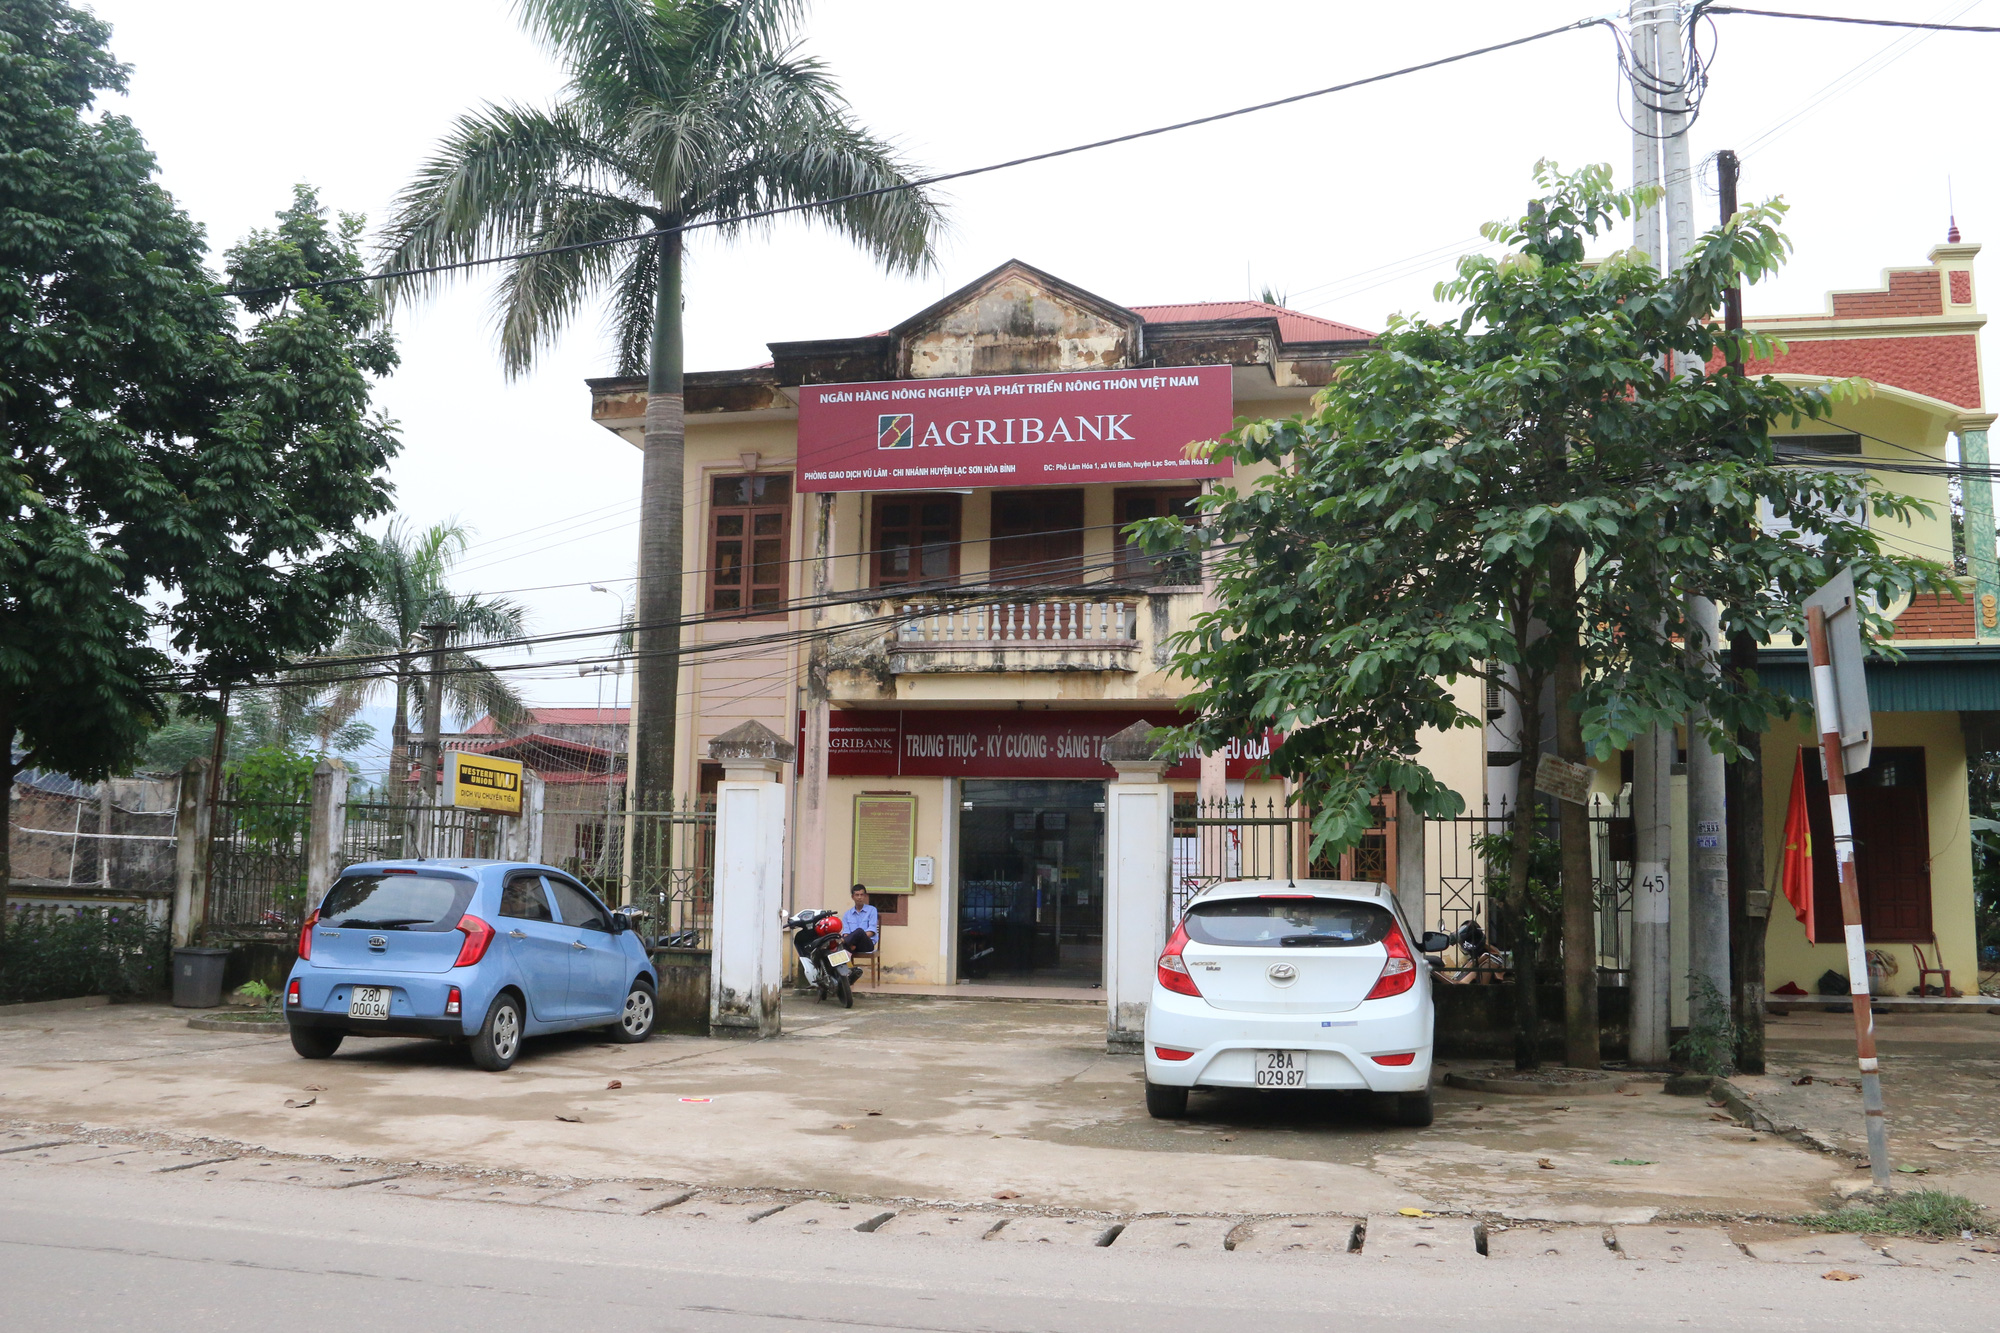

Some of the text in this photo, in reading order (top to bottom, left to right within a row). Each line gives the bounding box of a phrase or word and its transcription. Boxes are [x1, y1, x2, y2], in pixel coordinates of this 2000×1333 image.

[819, 375, 1200, 404] NGÂN HÀNG NÔNG NGHIỆP VÀ PHÁT TRIỂN NÔNG THÔN VIỆT NAM
[918, 413, 1136, 447] AGRIBANK
[804, 471, 827, 480] PHÒNG
[828, 471, 845, 480] GIAO
[845, 470, 862, 481] DỊCH
[862, 468, 872, 478] VŨ
[873, 468, 888, 478] LÂM
[892, 468, 904, 477] CHI
[904, 466, 929, 476] NHÁNH
[929, 465, 952, 477] HUYỆN
[952, 465, 967, 476] LẠC
[968, 464, 983, 474] SƠN
[983, 463, 999, 473] HÒA
[1000, 463, 1016, 473] BÌNH
[1094, 462, 1100, 470] 1,
[906, 734, 945, 757] TRUNG
[947, 732, 978, 765] THỰC
[987, 724, 1003, 758] KỶ
[1057, 728, 1090, 759] SÁNG
[461, 766, 494, 778] WESTERN
[471, 775, 493, 786] UNION
[1642, 875, 1664, 893] 45
[361, 989, 381, 1002] 28D
[352, 1002, 386, 1017] 000.94
[1267, 1053, 1294, 1069] 28A
[1257, 1071, 1304, 1086] 029.87
